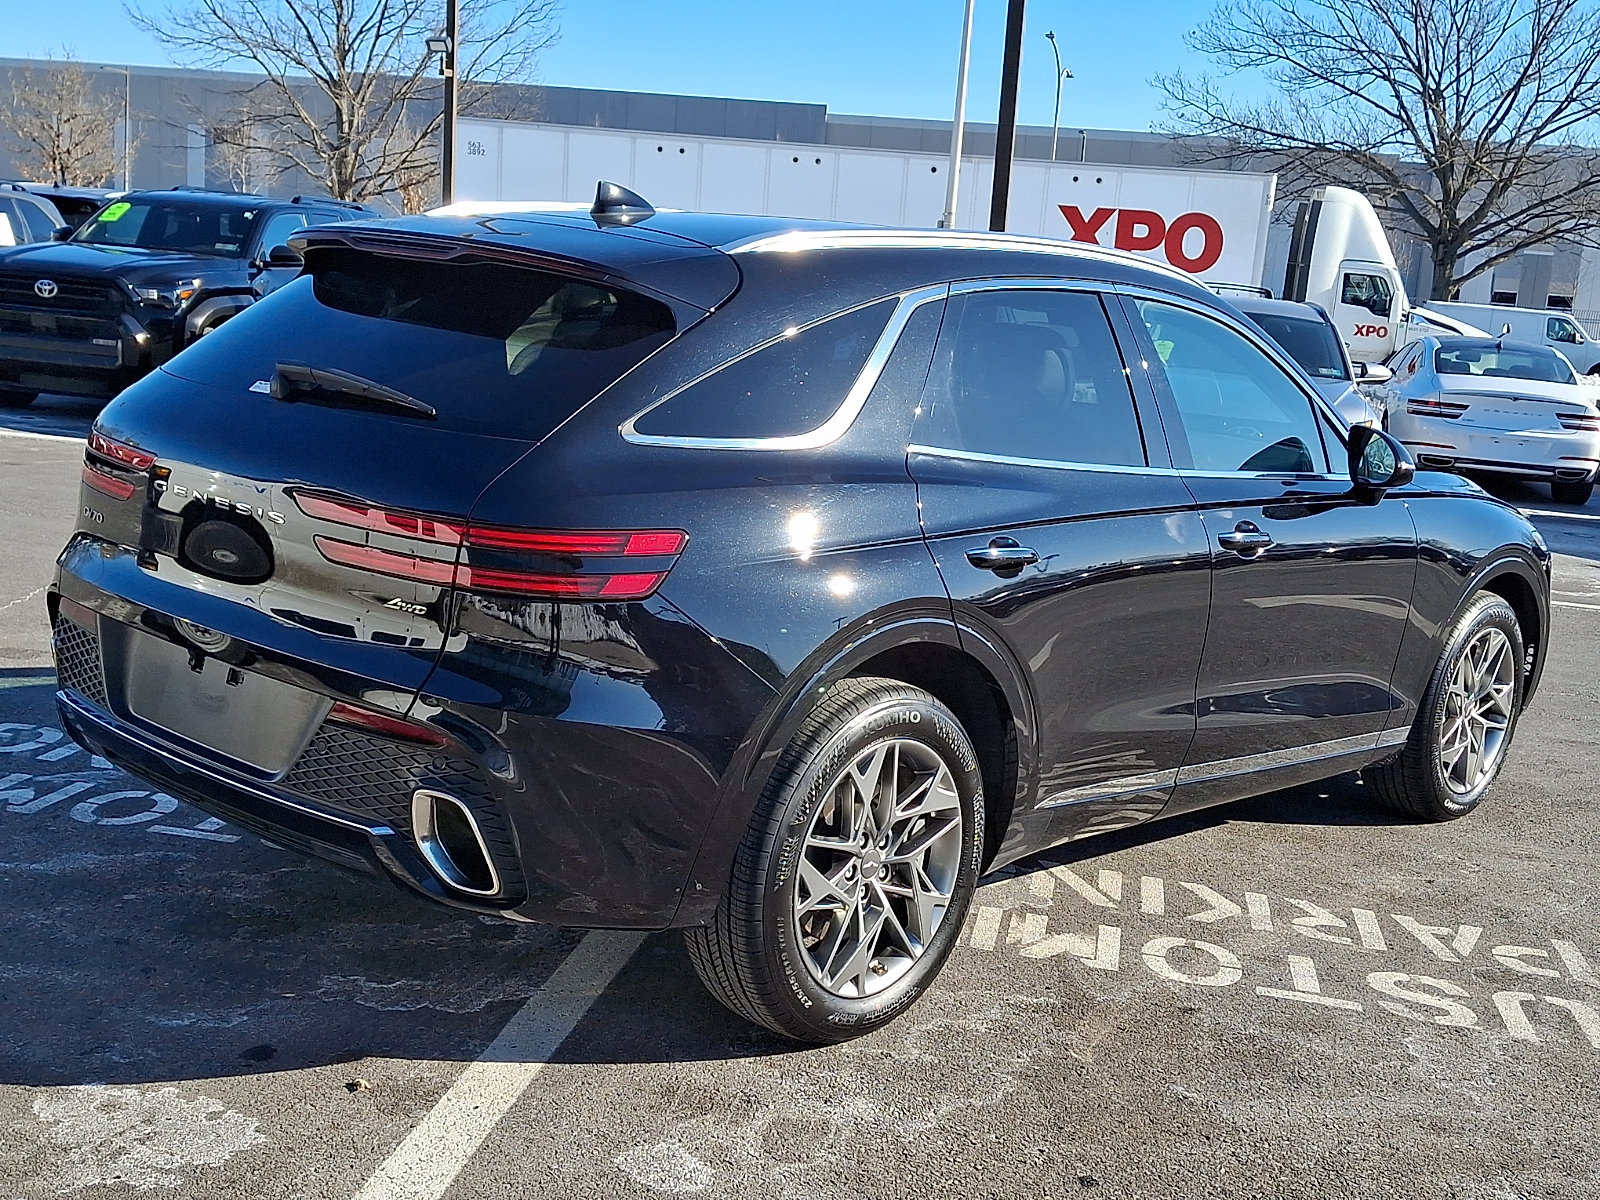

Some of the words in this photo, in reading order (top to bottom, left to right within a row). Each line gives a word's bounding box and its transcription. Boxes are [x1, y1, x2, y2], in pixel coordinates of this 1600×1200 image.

[1057, 205, 1224, 274] XPO
[1353, 323, 1389, 338] XPO
[153, 480, 286, 525] GENESIS
[382, 597, 428, 615] AWD
[863, 711, 921, 738] KUMHO
[1026, 864, 1600, 988] PARKIN
